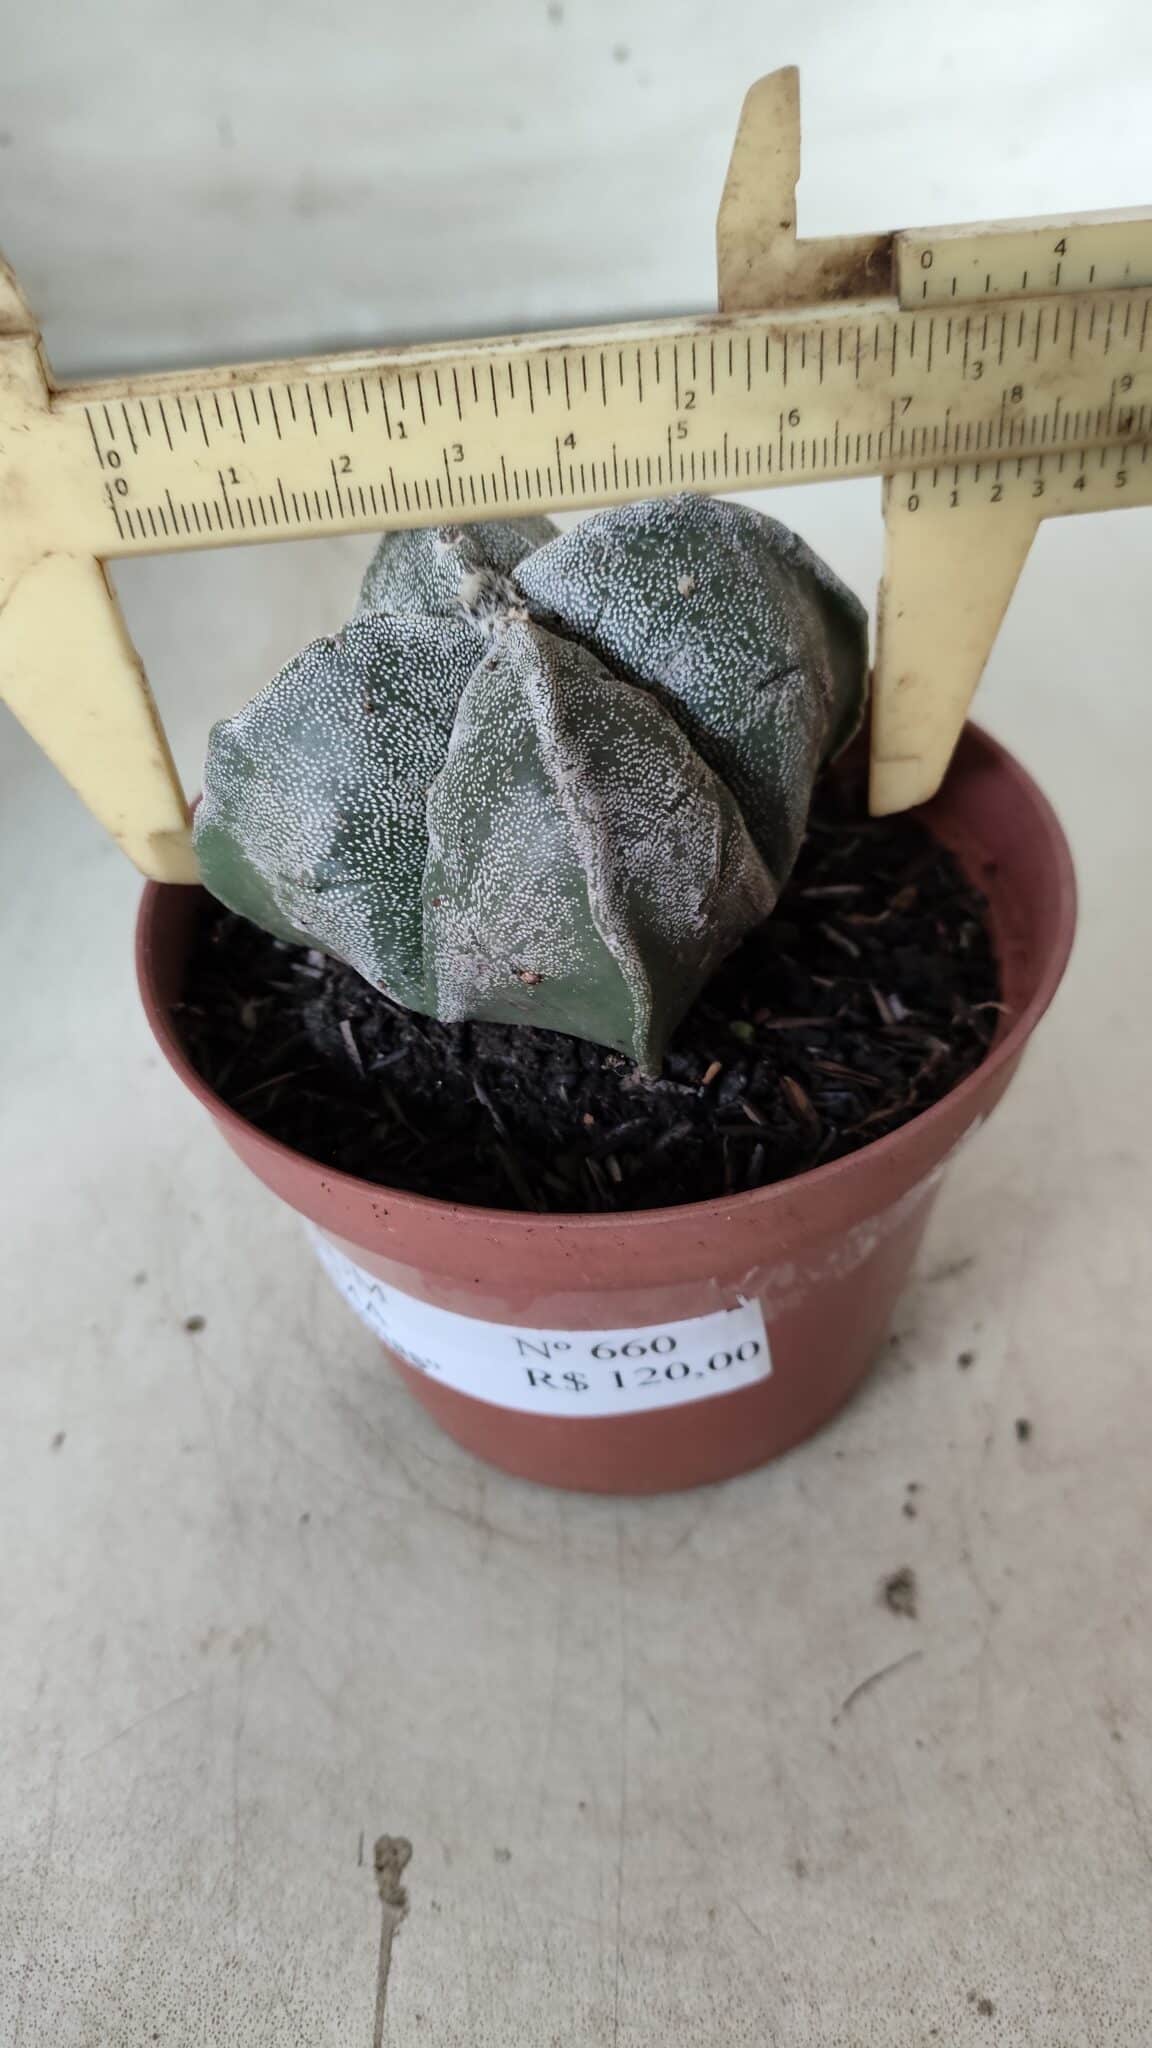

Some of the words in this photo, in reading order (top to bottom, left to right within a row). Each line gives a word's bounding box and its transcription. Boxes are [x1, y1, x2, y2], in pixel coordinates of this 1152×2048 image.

[920, 250, 934, 269] 0
[1053, 238, 1067, 257] 4
[106, 449, 122, 469] 0
[397, 421, 409, 440] 1
[684, 390, 697, 410] 2
[972, 361, 984, 380] 3
[114, 478, 129, 497] 0
[227, 466, 241, 485] 1
[339, 455, 353, 473] 2
[452, 444, 465, 462] 3
[563, 432, 577, 450] 4
[676, 421, 689, 439] 5
[787, 408, 801, 427] 6
[900, 396, 914, 414] 7
[1010, 384, 1024, 402] 8
[1119, 374, 1134, 392] 9
[907, 494, 920, 513] 0
[949, 490, 960, 508] 1
[990, 485, 1004, 503] 2
[1032, 480, 1045, 498] 3
[1072, 475, 1087, 492] 4
[1113, 470, 1128, 488] 5
[591, 1335, 677, 1360] 660
[525, 1367, 589, 1392] R$
